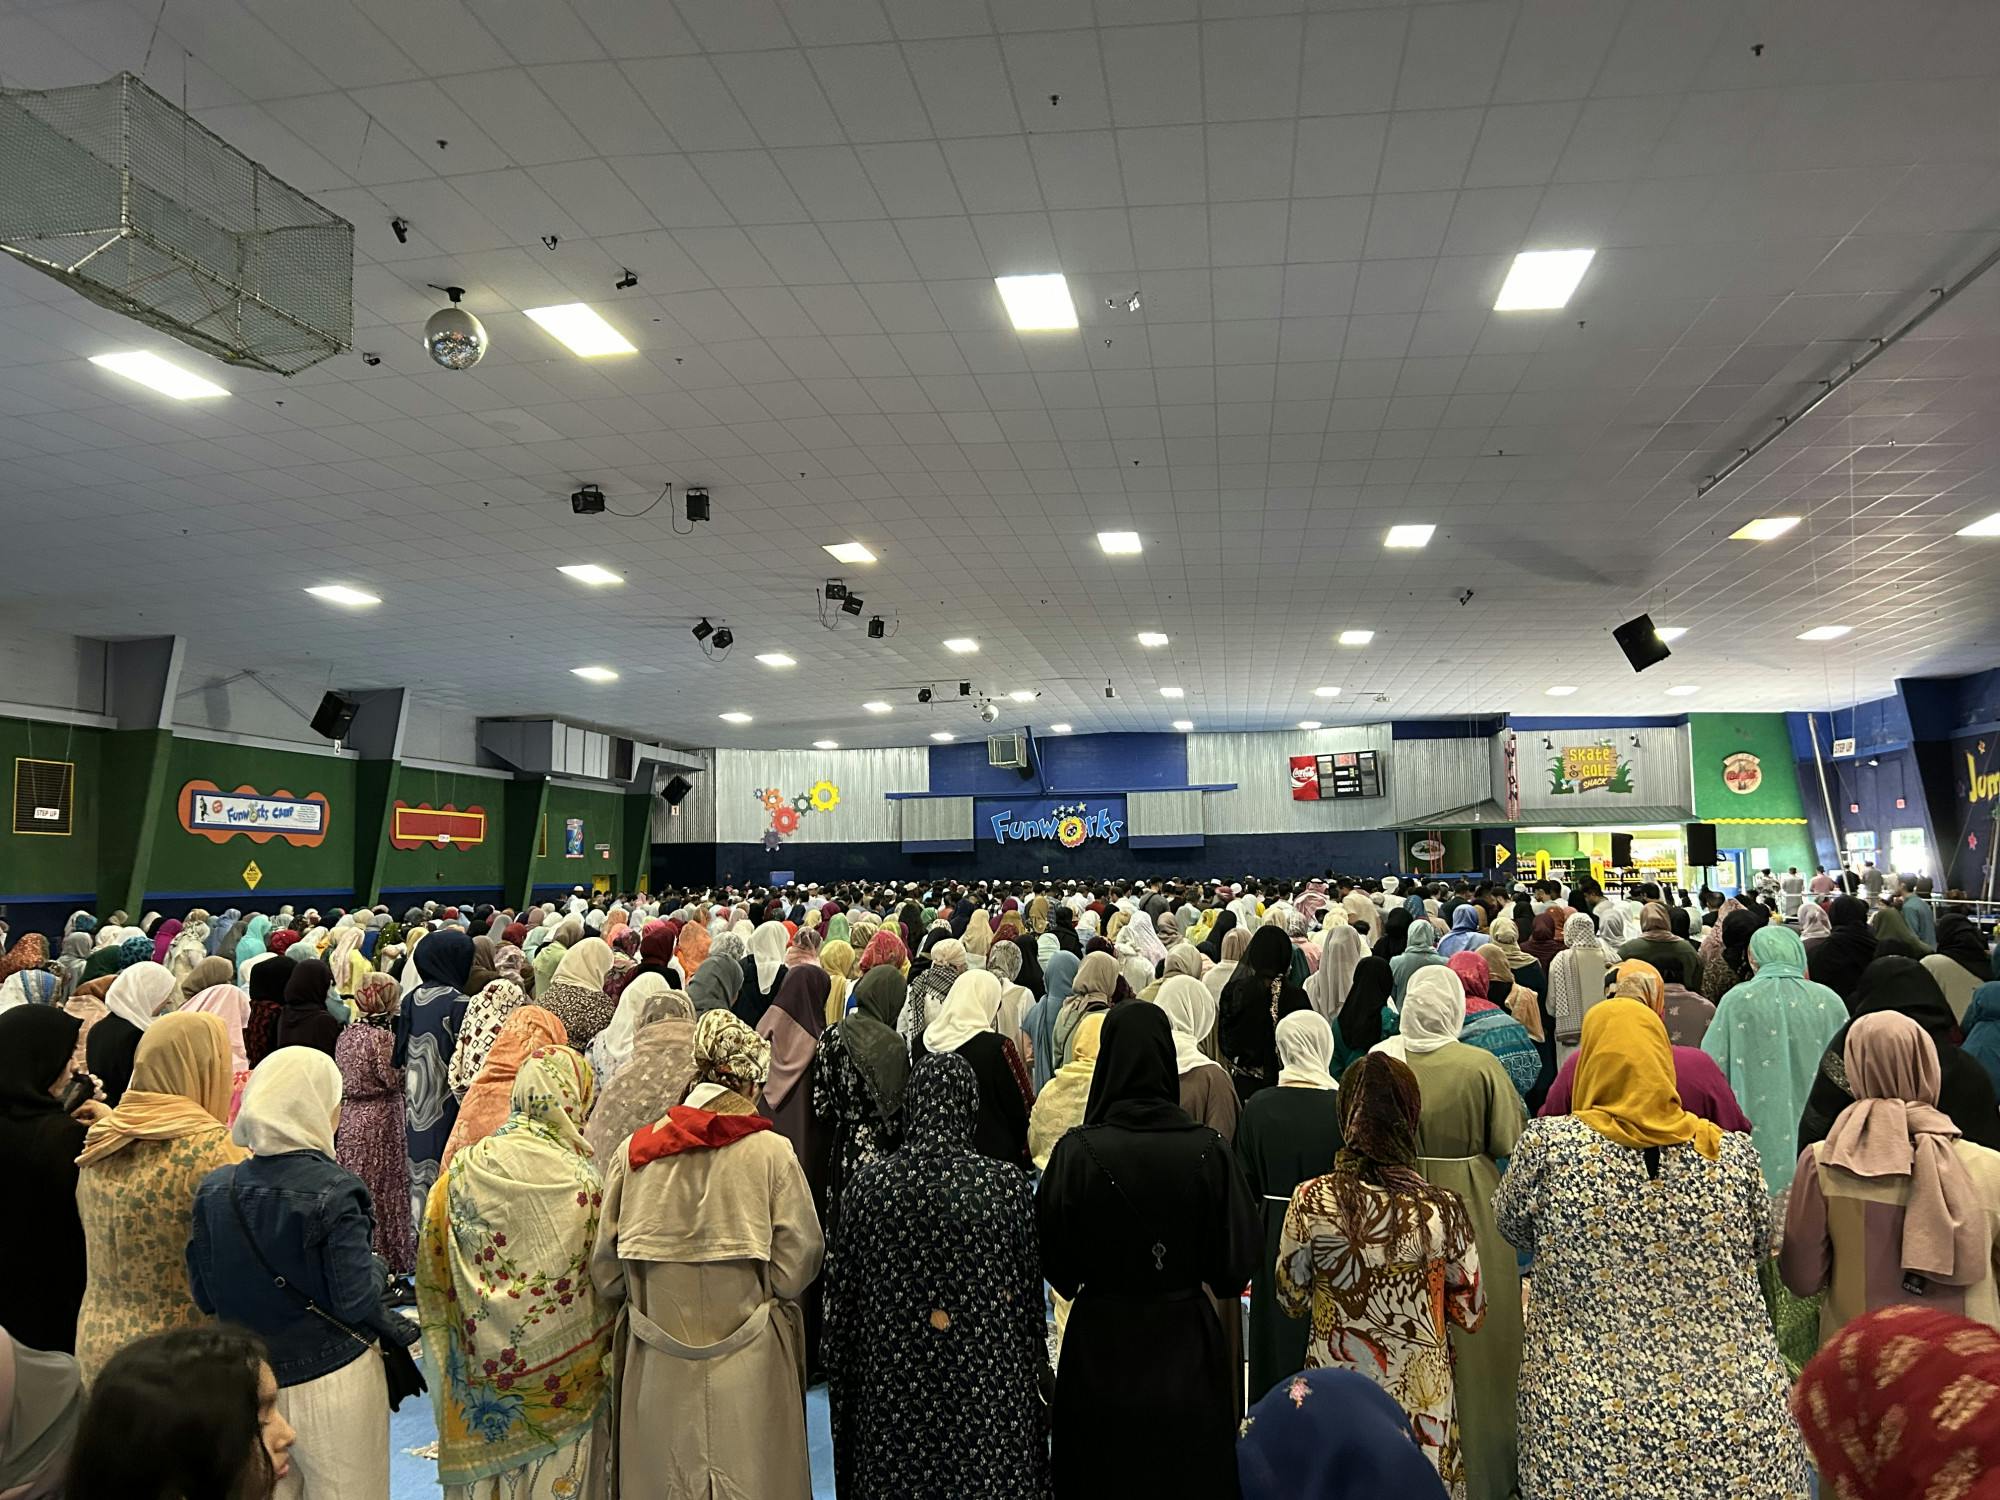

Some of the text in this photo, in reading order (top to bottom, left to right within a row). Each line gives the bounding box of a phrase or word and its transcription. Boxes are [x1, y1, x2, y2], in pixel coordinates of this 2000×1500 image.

[1569, 763, 1611, 778] & GOLF
[1583, 777, 1608, 789] SHACK
[36, 809, 49, 817] STEP
